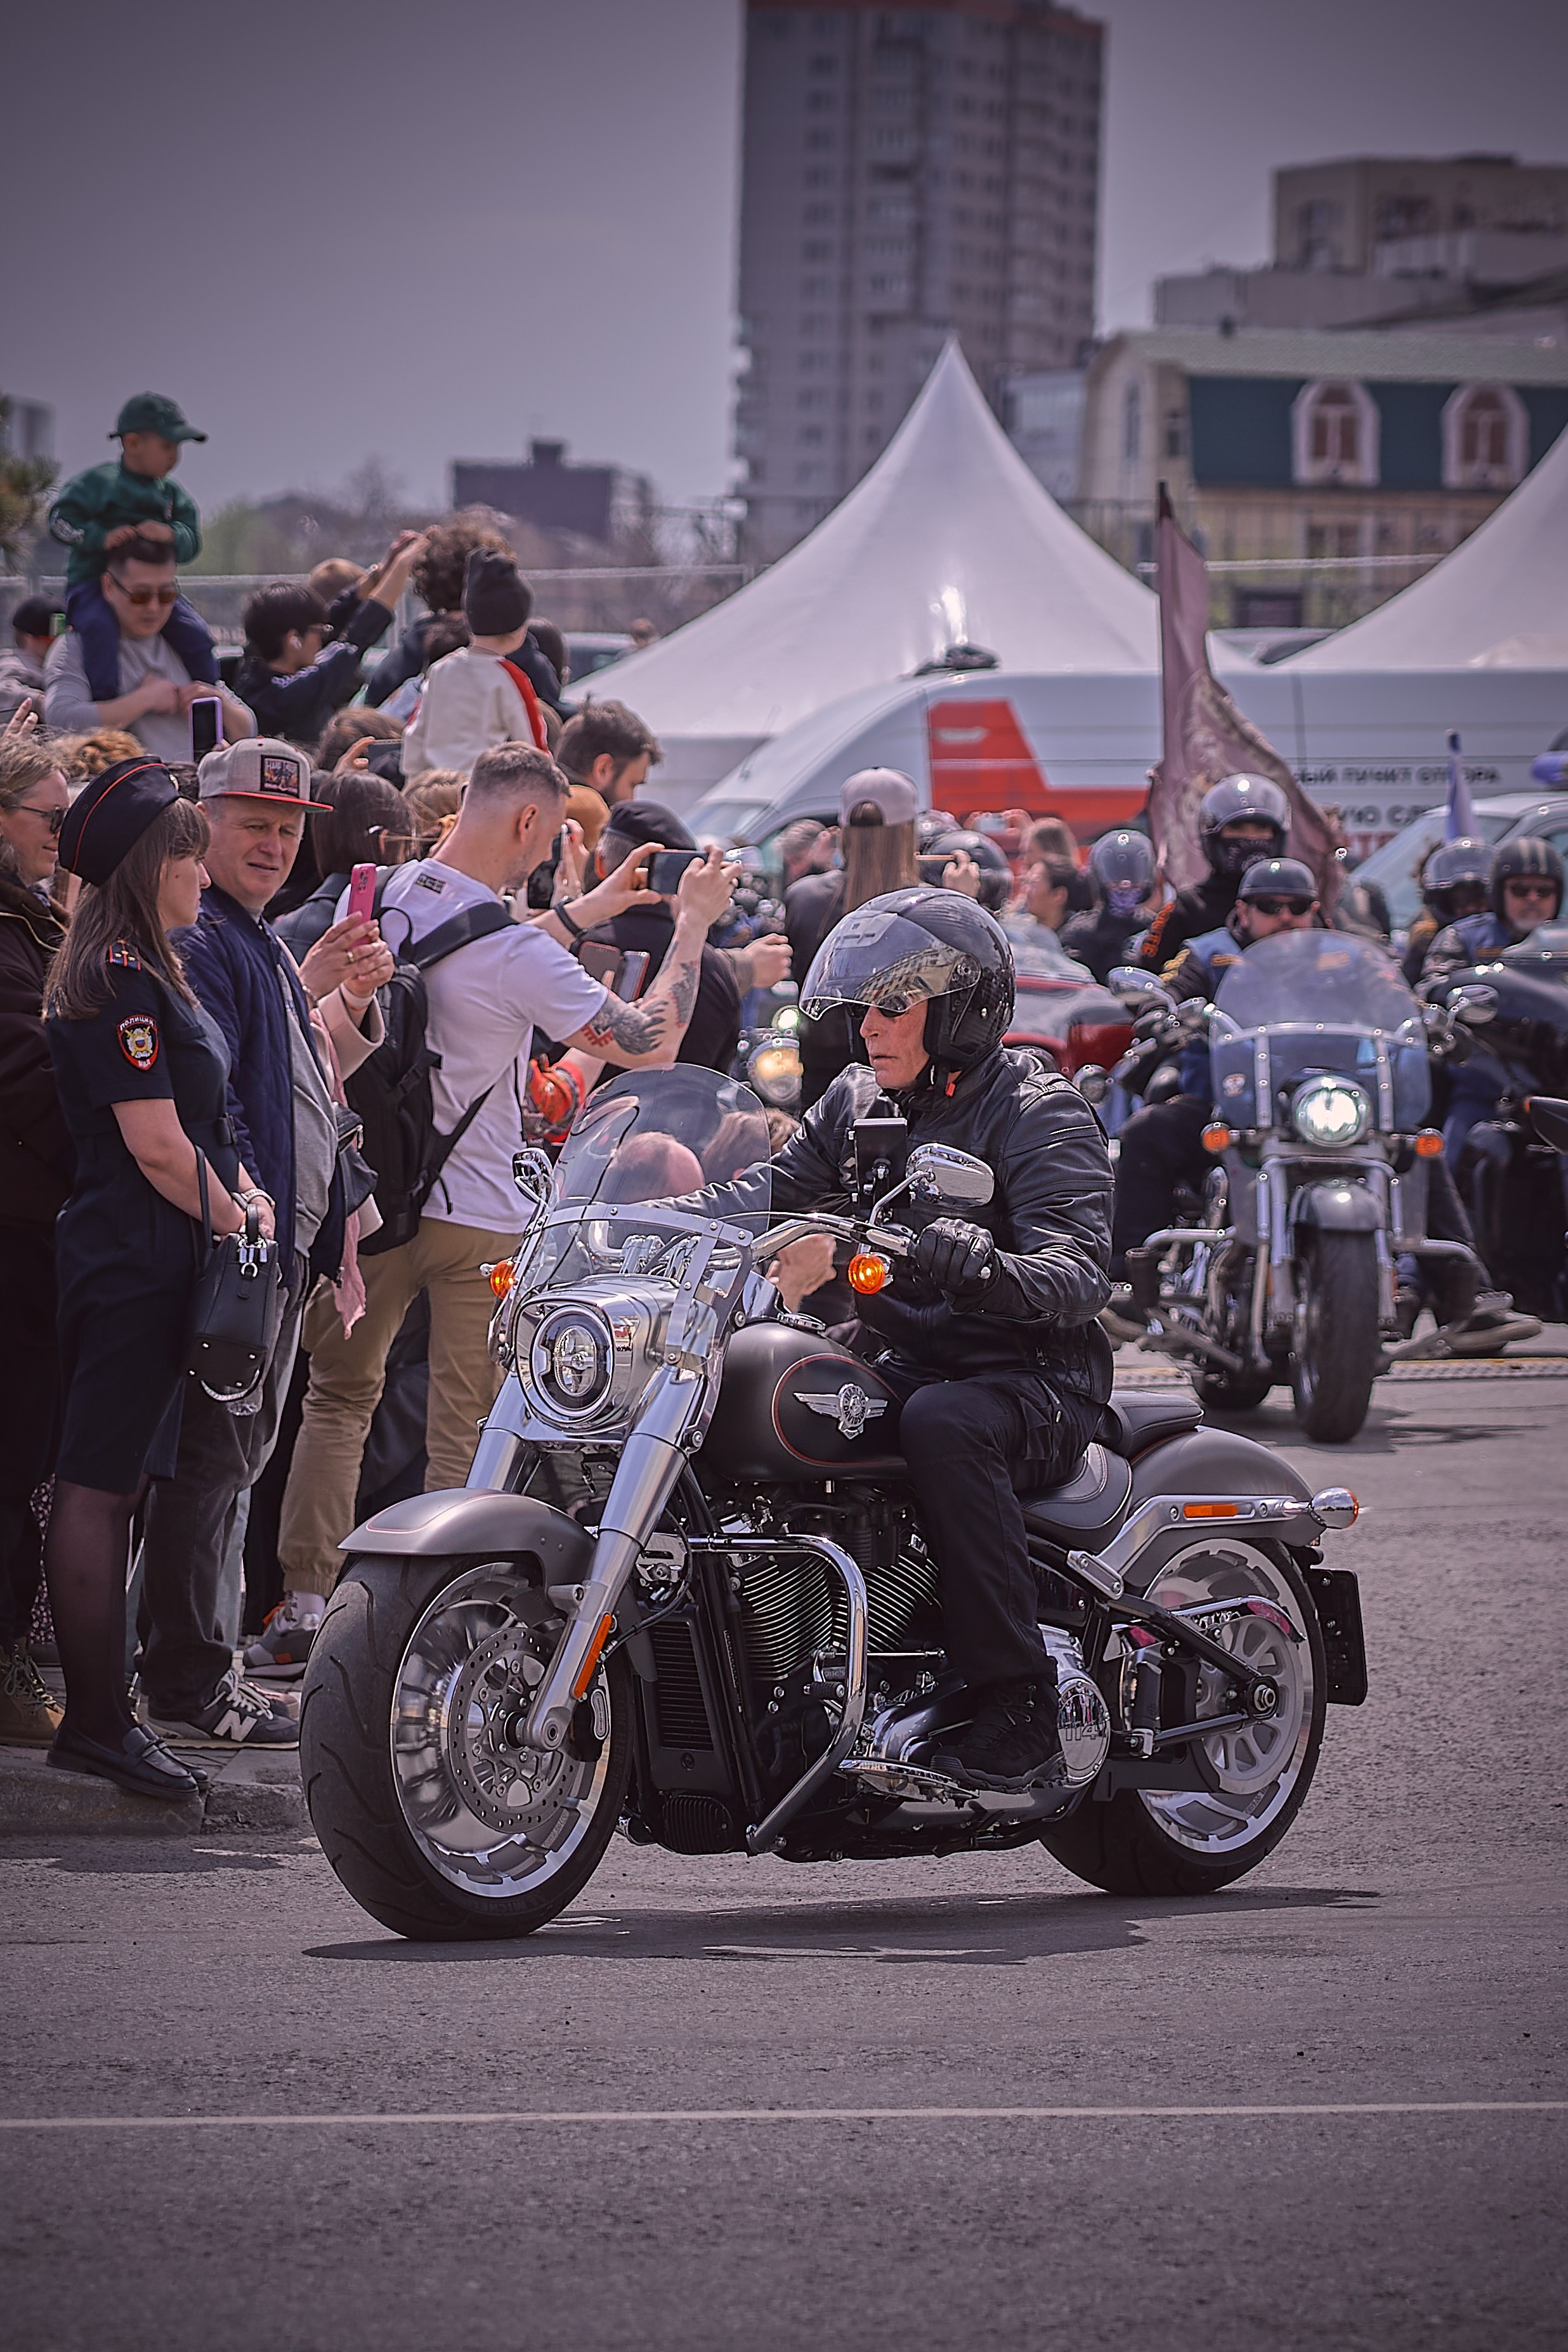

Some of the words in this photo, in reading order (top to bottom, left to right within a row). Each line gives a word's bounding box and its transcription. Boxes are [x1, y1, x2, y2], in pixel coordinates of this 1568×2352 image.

[120, 1016, 154, 1031] ПОЛИЦИЯ
[843, 1406, 866, 1425] DAVIDSON
[213, 1709, 258, 1742] N
